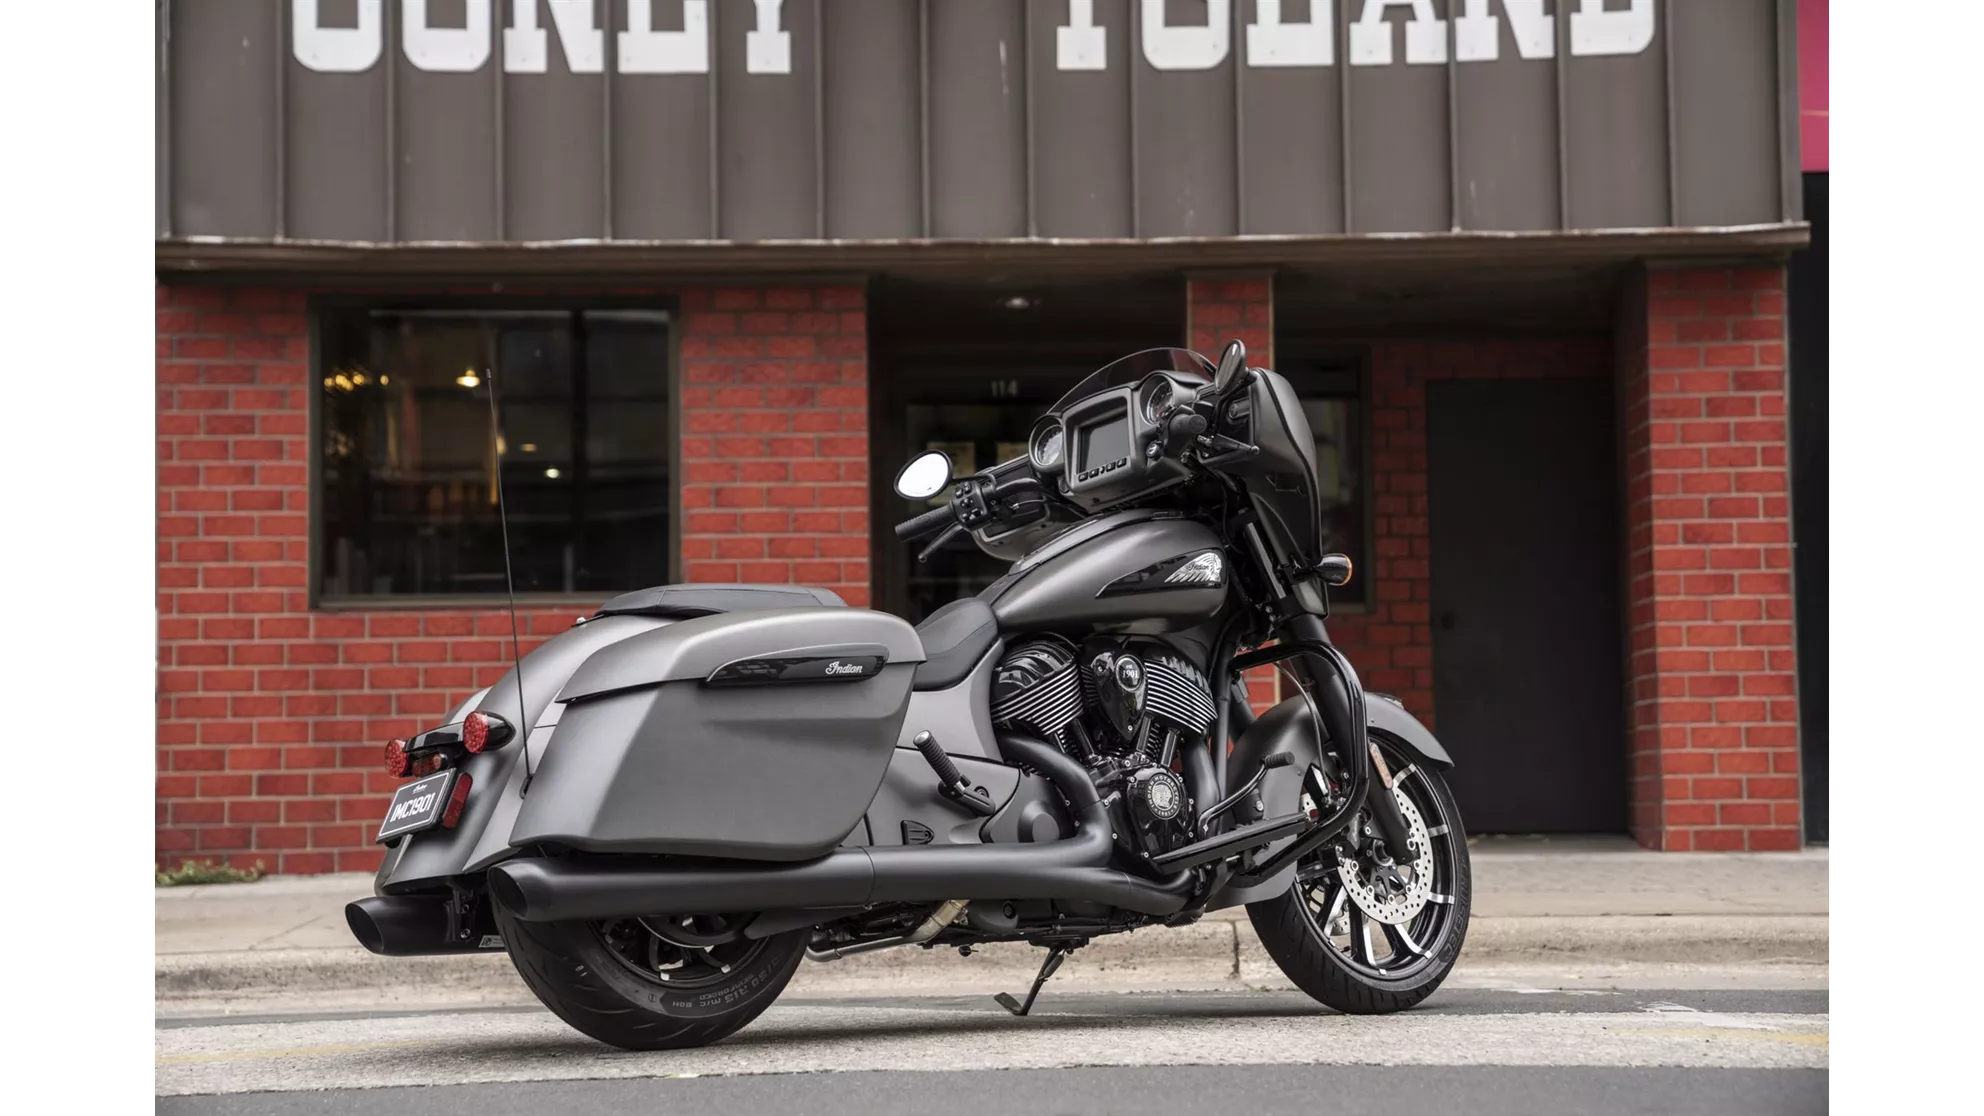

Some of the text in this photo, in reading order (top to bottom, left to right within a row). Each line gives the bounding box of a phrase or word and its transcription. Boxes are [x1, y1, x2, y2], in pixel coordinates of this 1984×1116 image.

[991, 379, 1018, 397] 114
[825, 661, 863, 675] Indian
[1122, 669, 1139, 679] 1901
[1154, 775, 1179, 809] MOTORCYCLE
[389, 792, 436, 823] IMC1901
